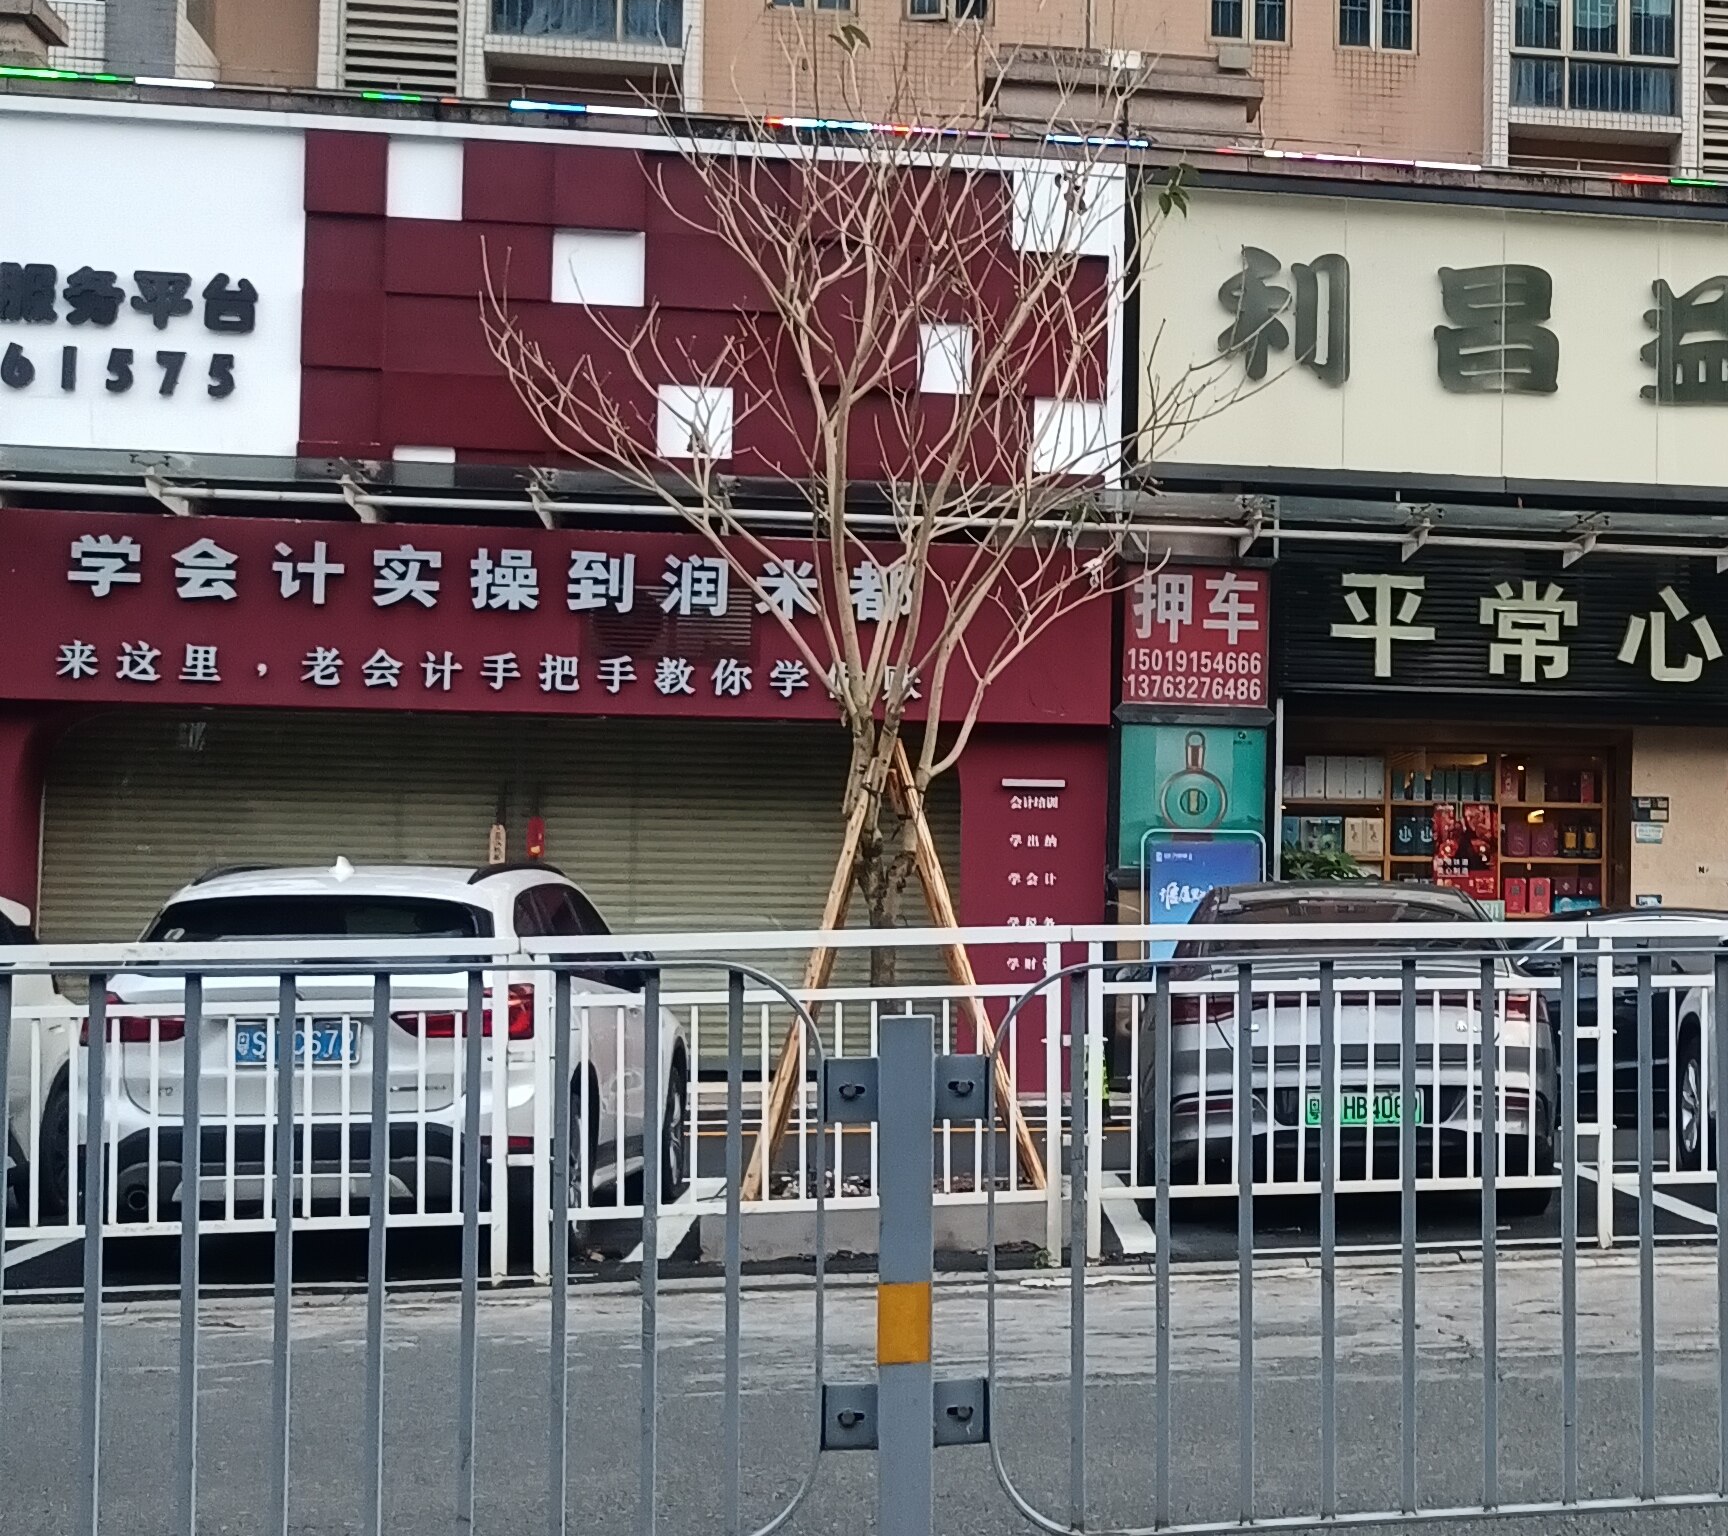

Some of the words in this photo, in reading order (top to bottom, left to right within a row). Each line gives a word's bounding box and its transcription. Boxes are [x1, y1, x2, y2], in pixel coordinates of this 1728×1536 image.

[0, 342, 236, 399] 61575
[67, 533, 914, 623] 学会计实操到润米都
[1133, 572, 1260, 645] 押车
[1127, 647, 1262, 674] 15019154666
[1330, 573, 1724, 683] 平常心
[1127, 674, 1262, 701] 13763276486
